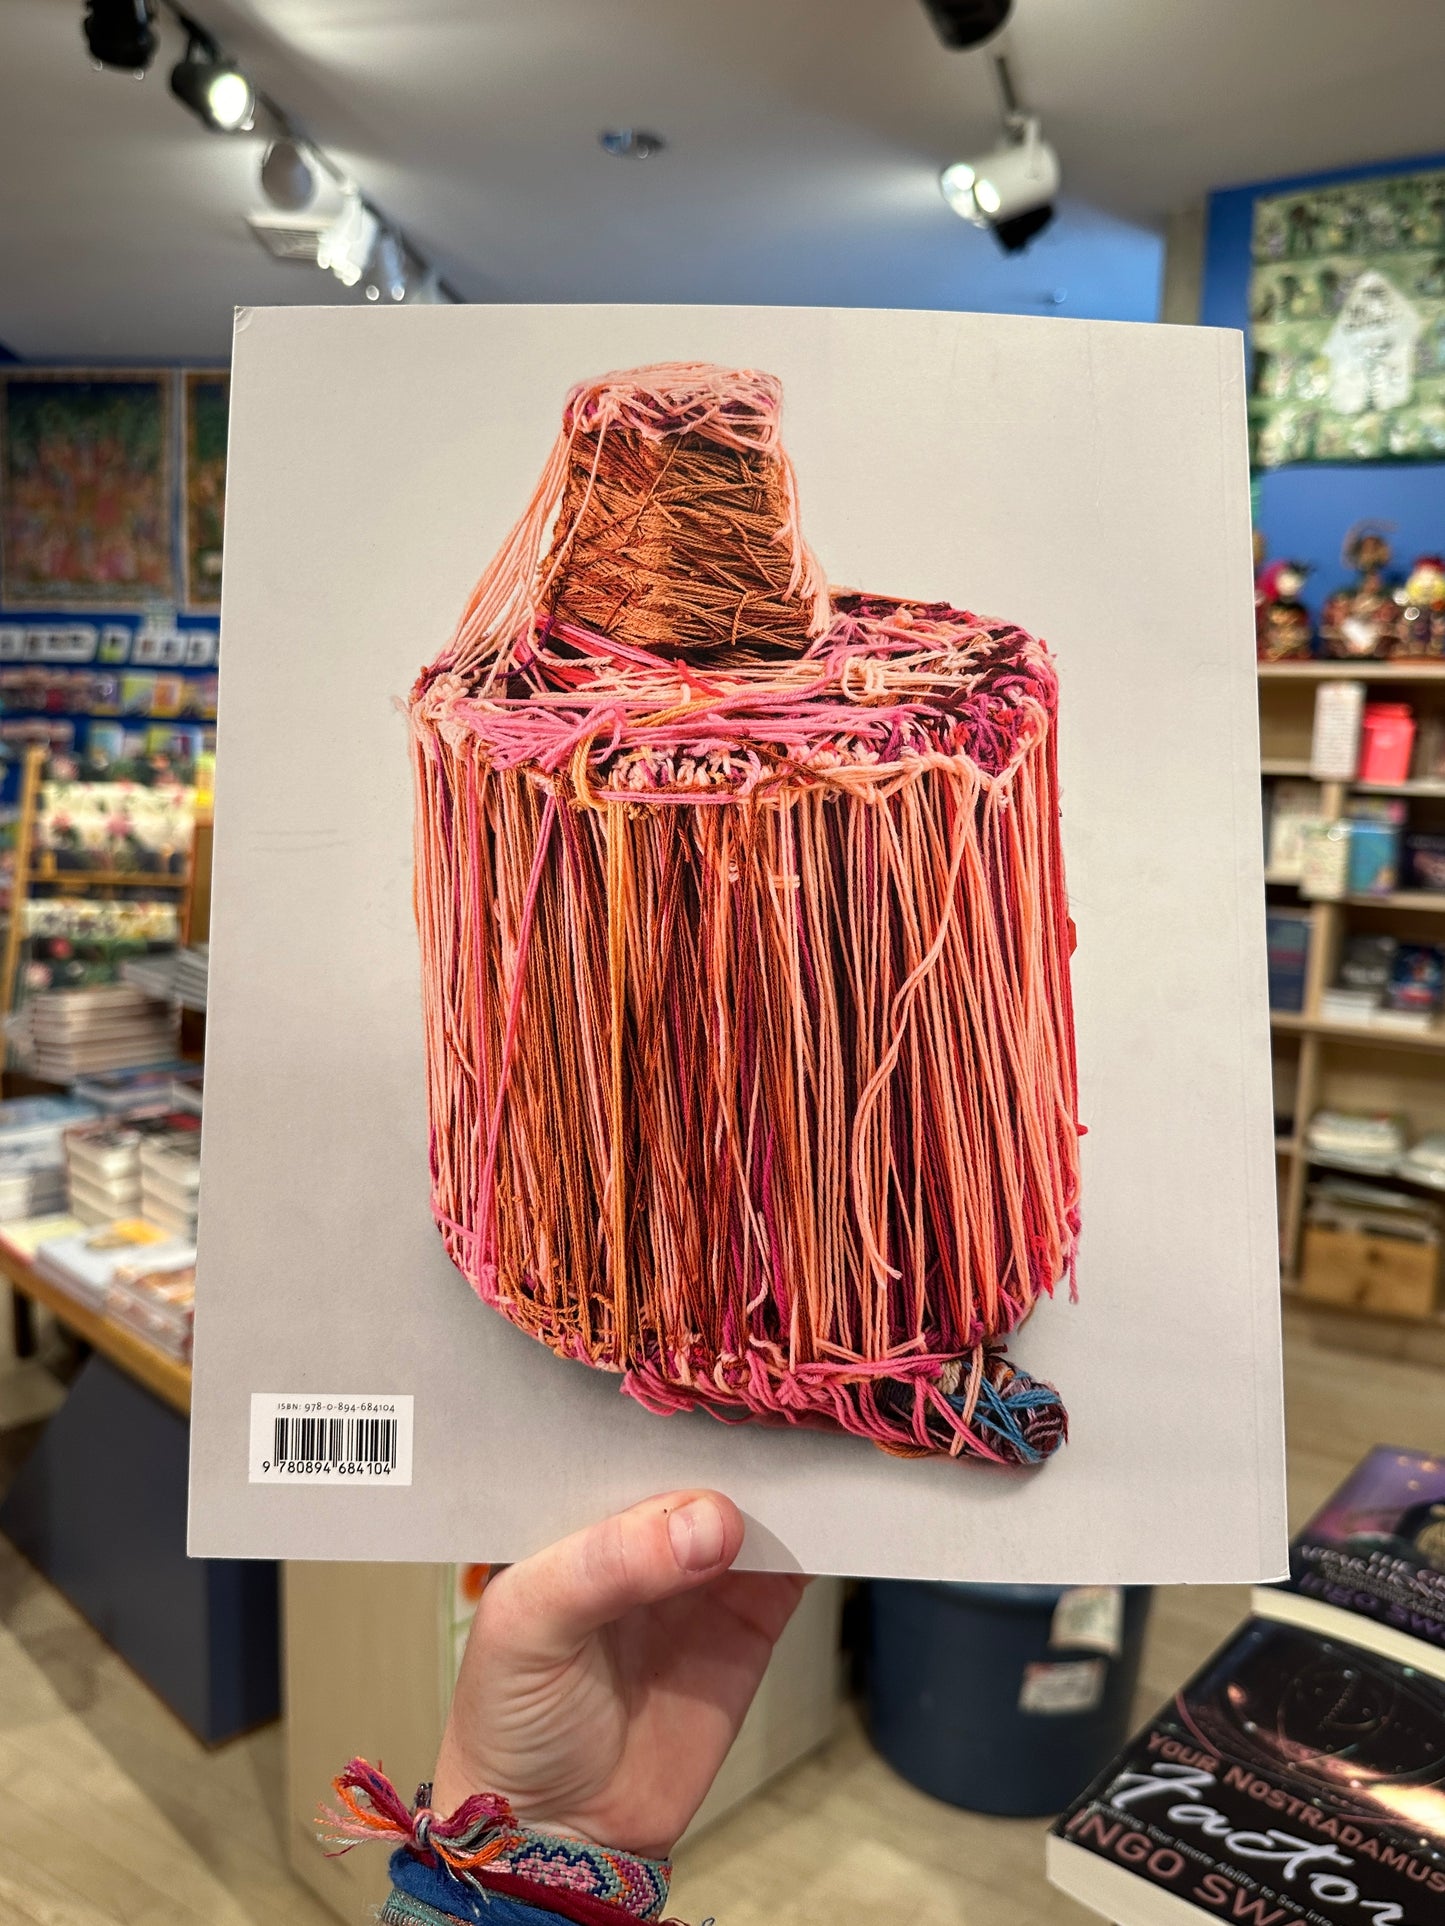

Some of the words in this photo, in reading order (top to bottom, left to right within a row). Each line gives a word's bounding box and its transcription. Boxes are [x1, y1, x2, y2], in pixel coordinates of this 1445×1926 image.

[262, 1461, 271, 1472] 9
[279, 1461, 331, 1474] 780894
[338, 1463, 391, 1475] 684104
[1147, 1732, 1220, 1772] YOUR
[1223, 1764, 1445, 1893] NOSTRADAMUS
[1065, 1808, 1185, 1878] INGO
[1260, 1885, 1276, 1900] to
[1277, 1894, 1305, 1914] See
